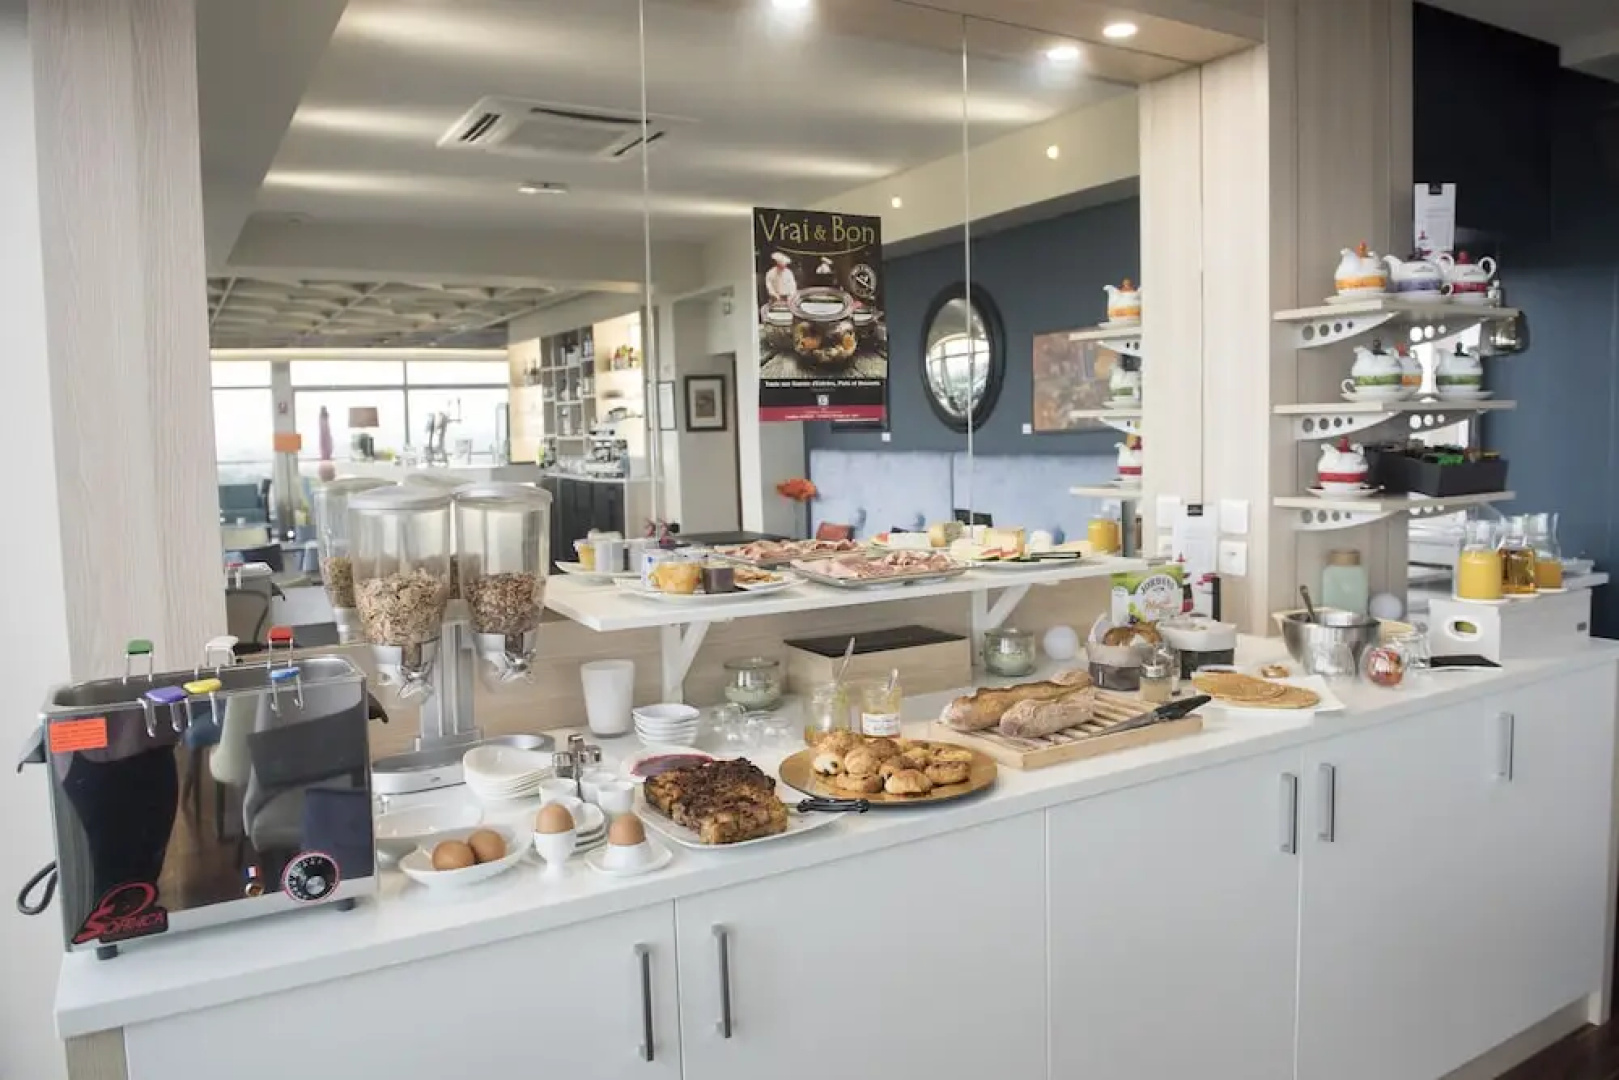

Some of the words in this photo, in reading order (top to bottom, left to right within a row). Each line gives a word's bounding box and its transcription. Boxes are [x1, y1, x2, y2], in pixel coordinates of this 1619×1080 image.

[759, 213, 809, 243] Vrai
[814, 224, 827, 241] &
[831, 215, 875, 244] Bon
